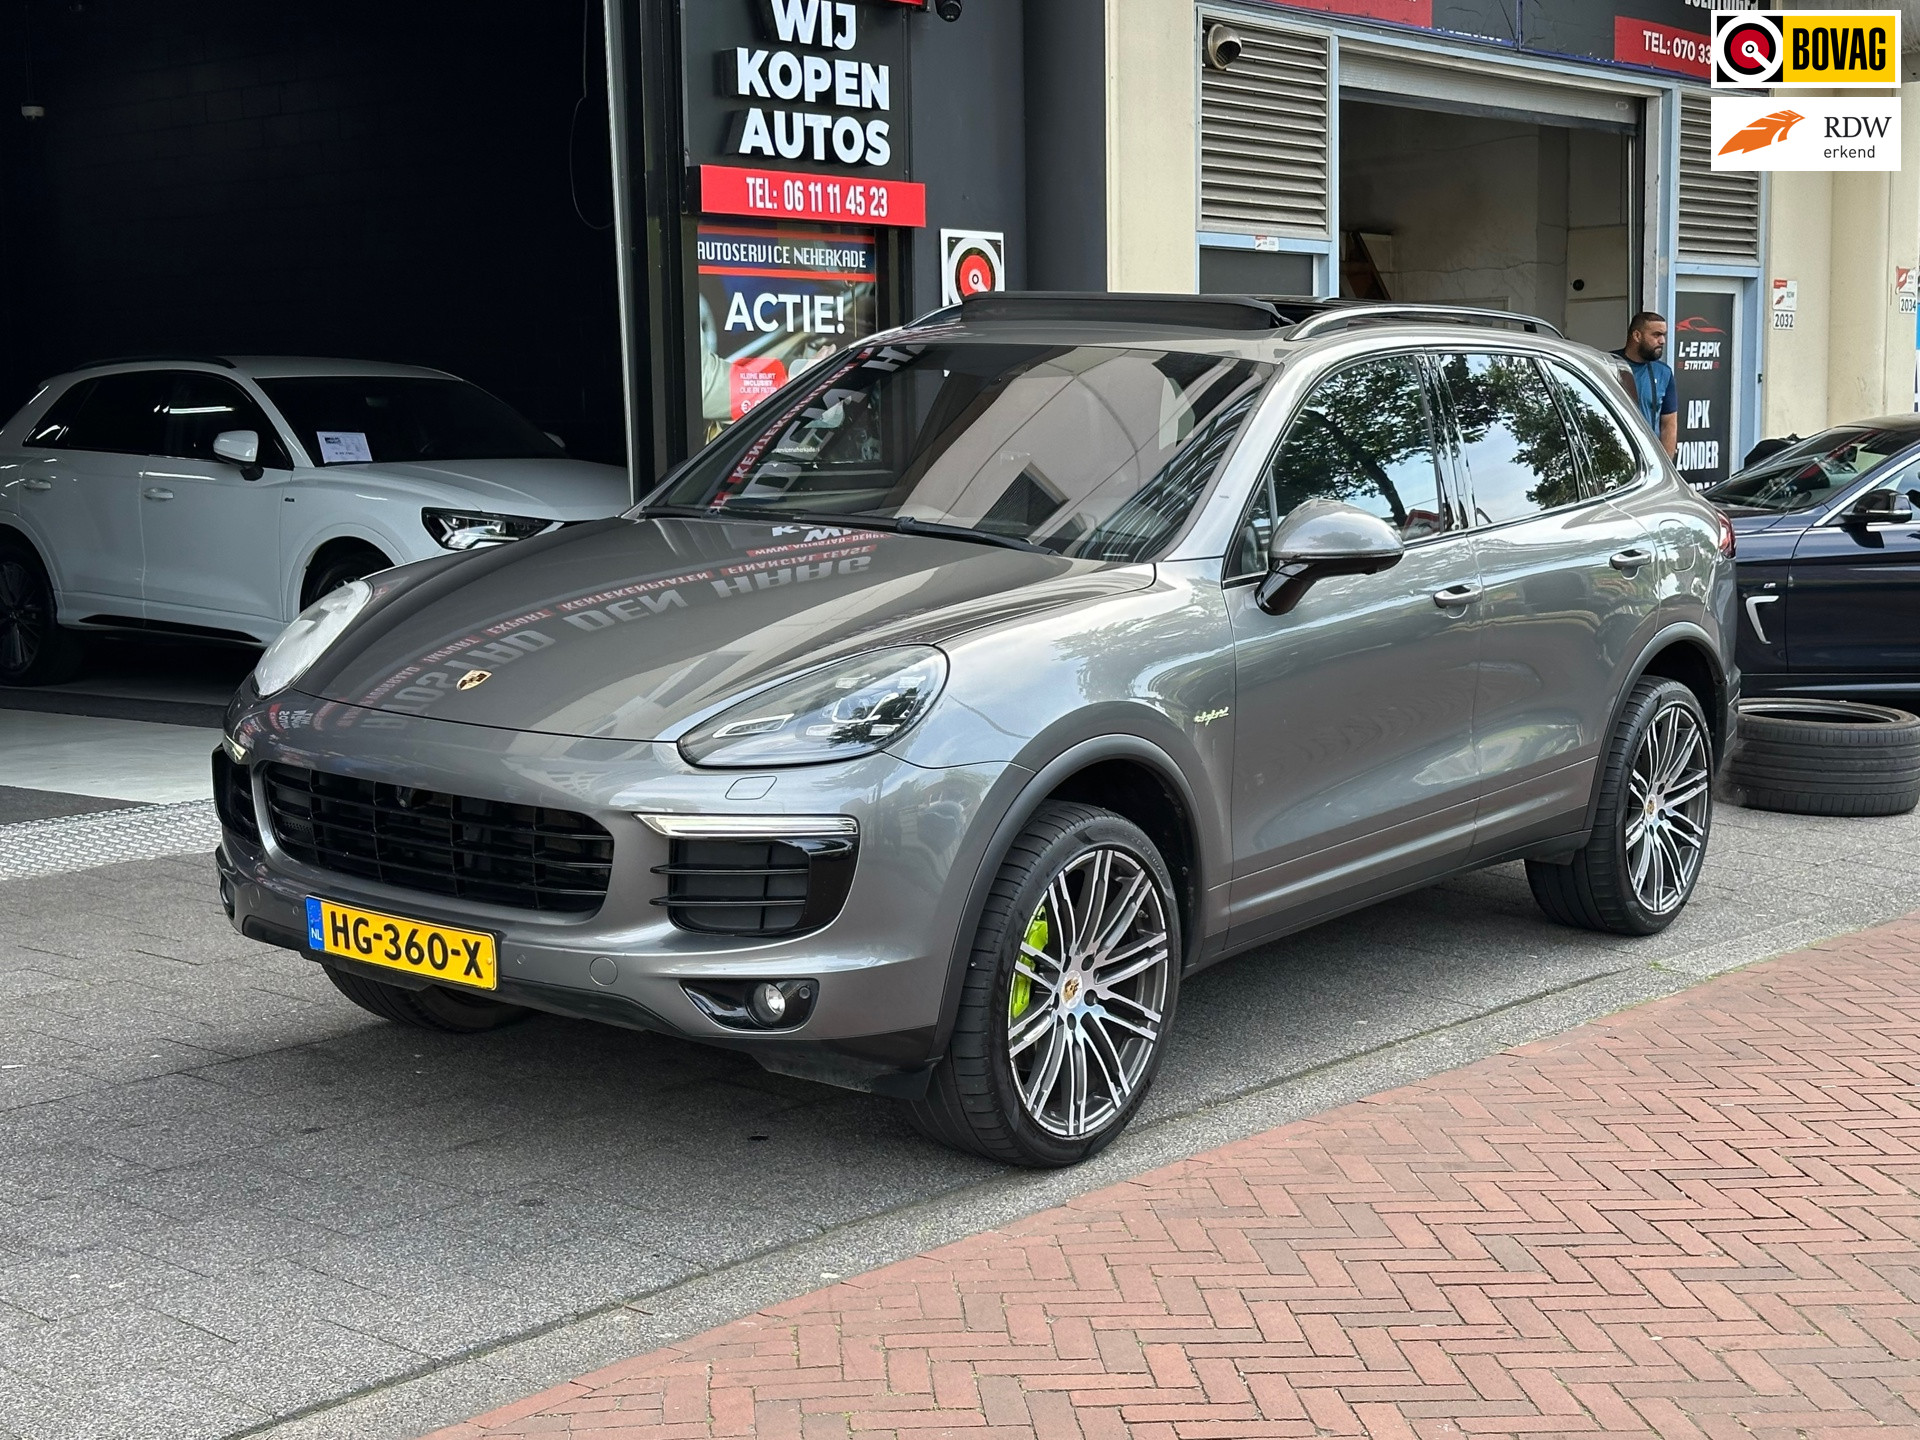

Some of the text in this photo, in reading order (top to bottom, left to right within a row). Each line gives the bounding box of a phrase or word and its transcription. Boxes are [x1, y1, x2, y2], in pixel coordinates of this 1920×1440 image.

[770, 0, 857, 50] WIJ
[1642, 29, 1671, 56] TEL:
[1673, 37, 1696, 61] 070
[736, 47, 890, 111] KOPEN
[738, 107, 891, 166] AUTOS
[745, 177, 888, 217] TEL: 06 11 11 45 23
[697, 241, 867, 268] AUTOSERVICE NEHERKADE
[724, 291, 845, 334] ACTIE!
[1774, 313, 1794, 328] 2032
[1900, 298, 1916, 312] 2034
[1683, 360, 1713, 370] STATION
[1699, 341, 1721, 358] APK
[1686, 399, 1711, 430] APK
[1676, 440, 1719, 471] ZONDER
[311, 929, 323, 941] NL
[330, 911, 484, 979] HG-360-X
